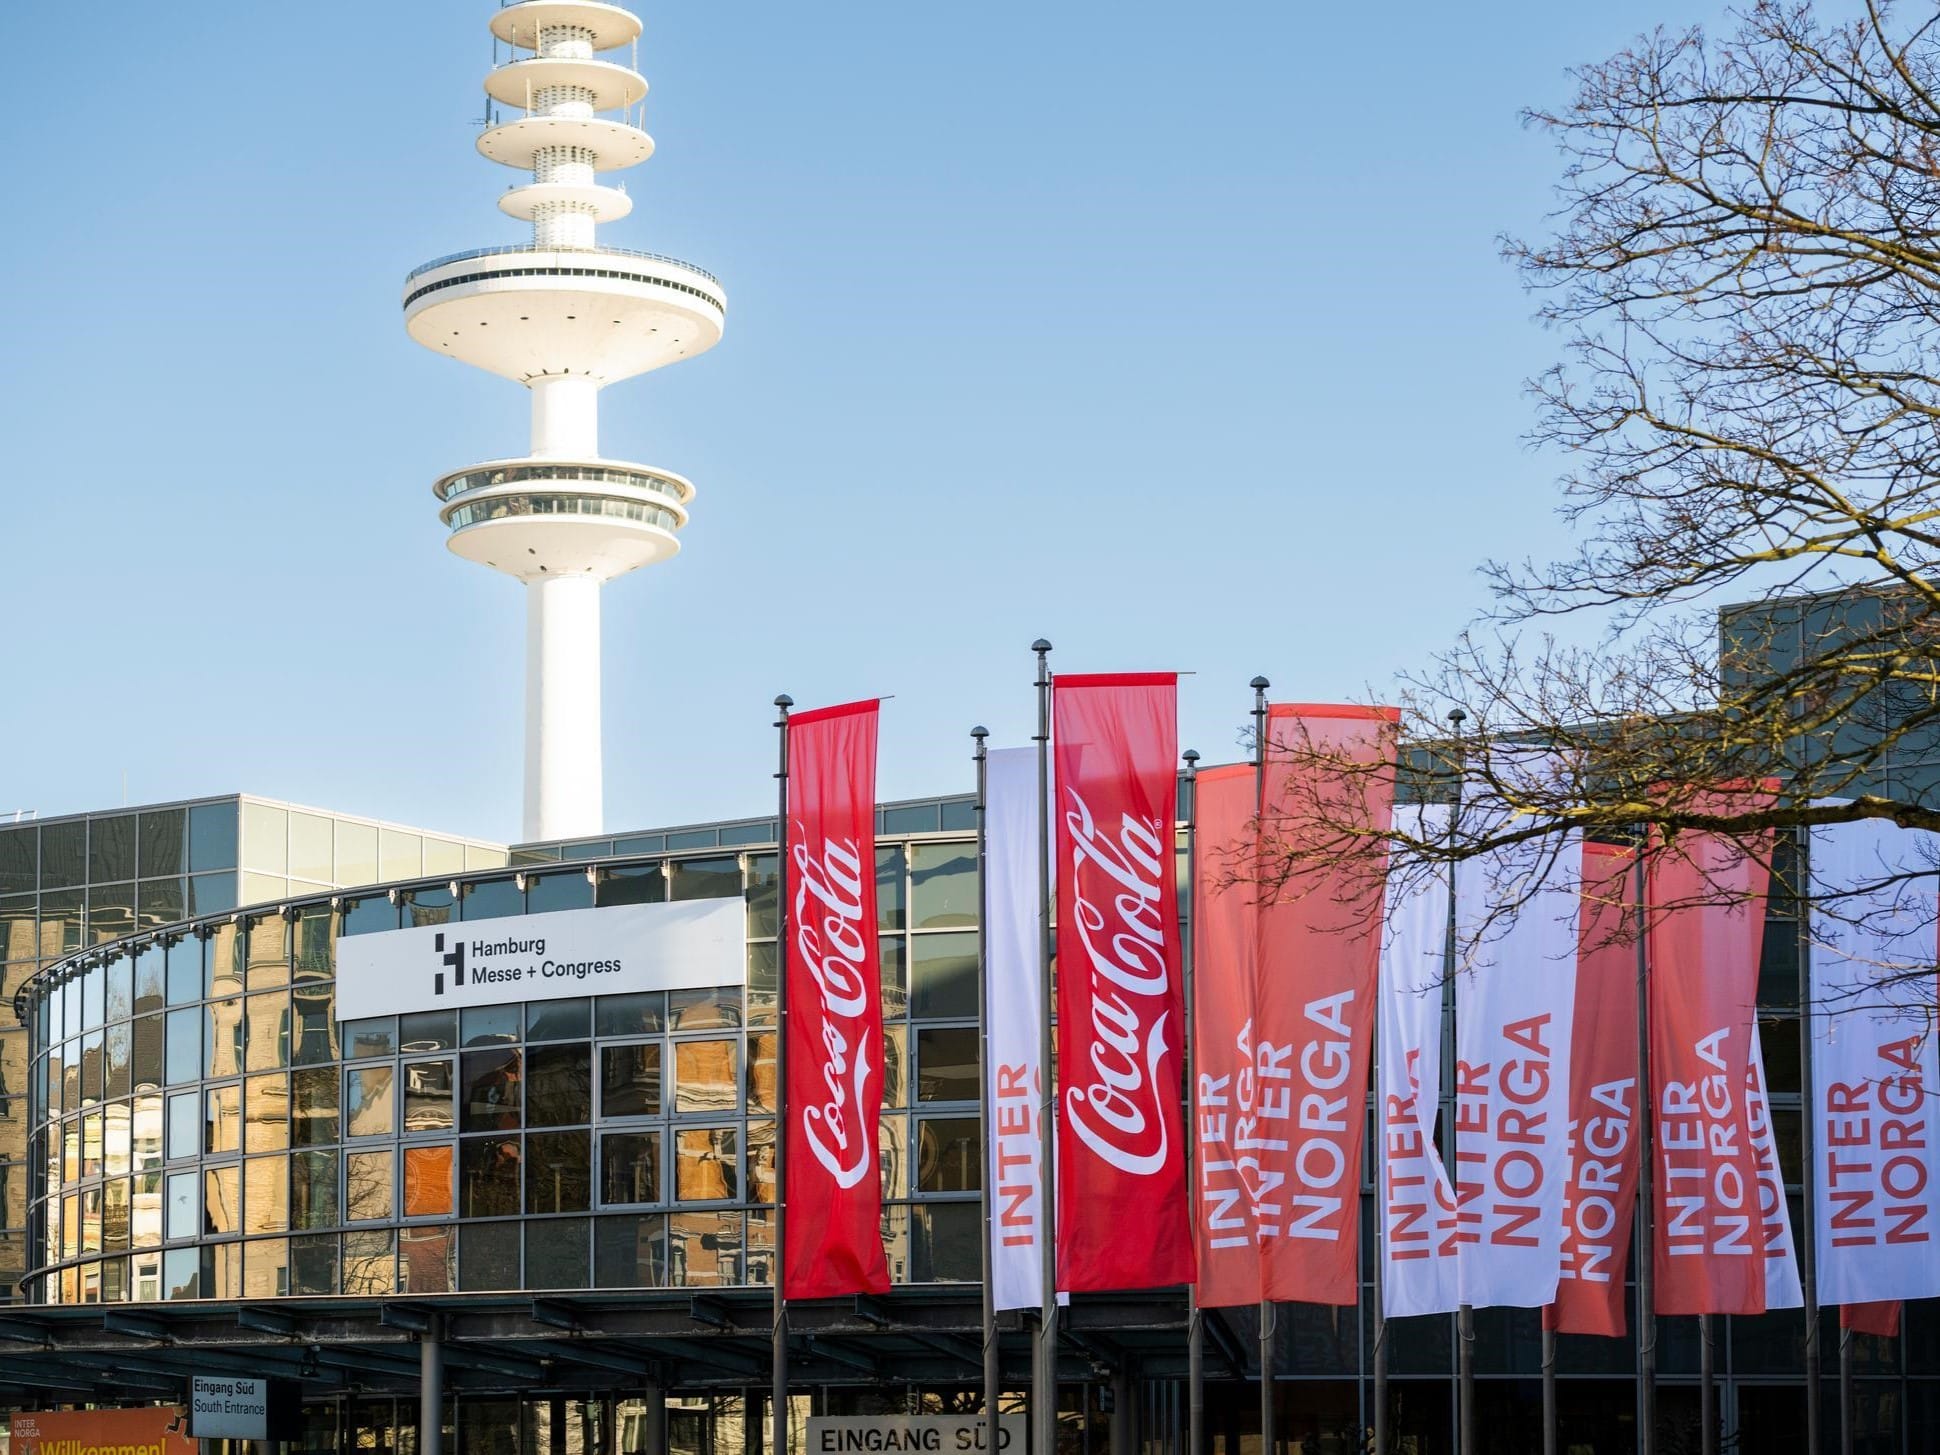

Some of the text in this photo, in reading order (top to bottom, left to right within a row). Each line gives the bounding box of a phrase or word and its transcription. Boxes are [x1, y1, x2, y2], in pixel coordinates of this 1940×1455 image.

[472, 937, 546, 958] Hamburg
[472, 966, 522, 985] Messe
[541, 959, 622, 979] Congress
[794, 819, 872, 1190] Coca-Cola
[1067, 785, 1169, 1176] Coca-Cola
[997, 1062, 1034, 1248] INTER
[1200, 1072, 1250, 1249] INTER
[1288, 989, 1355, 1241] NORGA
[1386, 1093, 1431, 1261] INTER
[1490, 1012, 1552, 1248] NORGA
[1575, 1077, 1636, 1283] NORGA
[1661, 1081, 1706, 1256] INTER
[1695, 1026, 1753, 1255] NORGA
[1827, 1081, 1877, 1248] INTER
[1877, 1035, 1930, 1245] NORGA
[14, 1419, 36, 1428] INTER
[14, 1428, 41, 1438] NORGA
[194, 1380, 255, 1396] Eingang Süd
[194, 1400, 265, 1416] South Entrance
[821, 1427, 940, 1453] EINGANG
